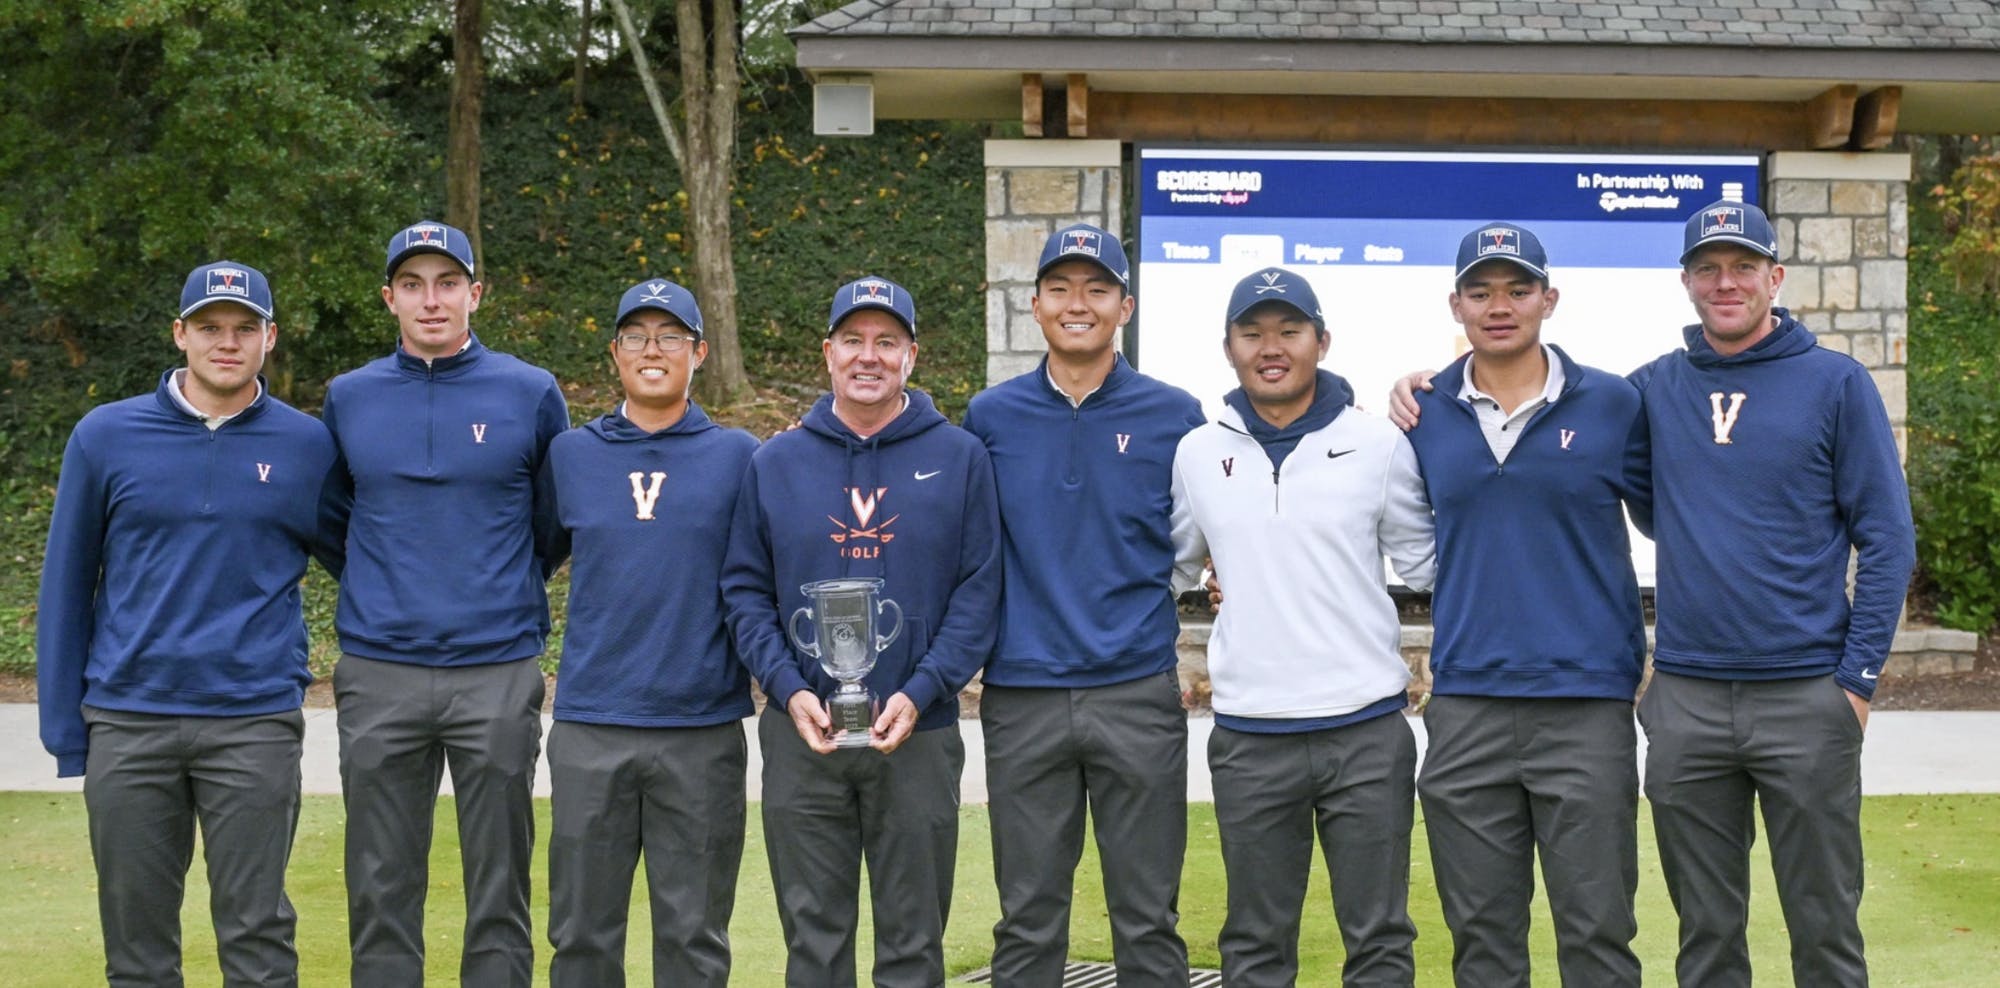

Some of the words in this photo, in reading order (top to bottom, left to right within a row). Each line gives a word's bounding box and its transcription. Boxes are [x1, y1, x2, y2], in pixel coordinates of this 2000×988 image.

[1157, 171, 1262, 191] SCOREBOARD
[1577, 173, 1590, 189] In
[1593, 173, 1669, 192] Partnership
[1671, 173, 1704, 190] With
[1171, 192, 1208, 203] Powered
[1209, 193, 1222, 204] by
[1708, 207, 1737, 217] VIRGINIA
[412, 225, 440, 233] VIRGINIA
[1069, 230, 1095, 239] VIRGINIA
[1485, 228, 1513, 237] VIRGINIA
[1705, 224, 1739, 235] CAVALIERS
[410, 240, 443, 248] CAVALIERS
[1482, 244, 1516, 254] CAVALIERS
[1064, 246, 1097, 255] CAVALIERS
[1162, 242, 1210, 259] Times
[1295, 243, 1343, 264] Player
[1364, 244, 1404, 262] Stats
[214, 268, 243, 277] VIRGINIA
[211, 285, 245, 295] CAVALIERS
[861, 280, 889, 289] VIRGINIA
[857, 294, 889, 304] CAVALIERS
[1709, 392, 1747, 444] V
[472, 424, 486, 443] V
[1561, 429, 1576, 449] V
[1117, 434, 1130, 453] V
[257, 463, 271, 482] V
[1222, 457, 1234, 477] V
[628, 471, 667, 520] V
